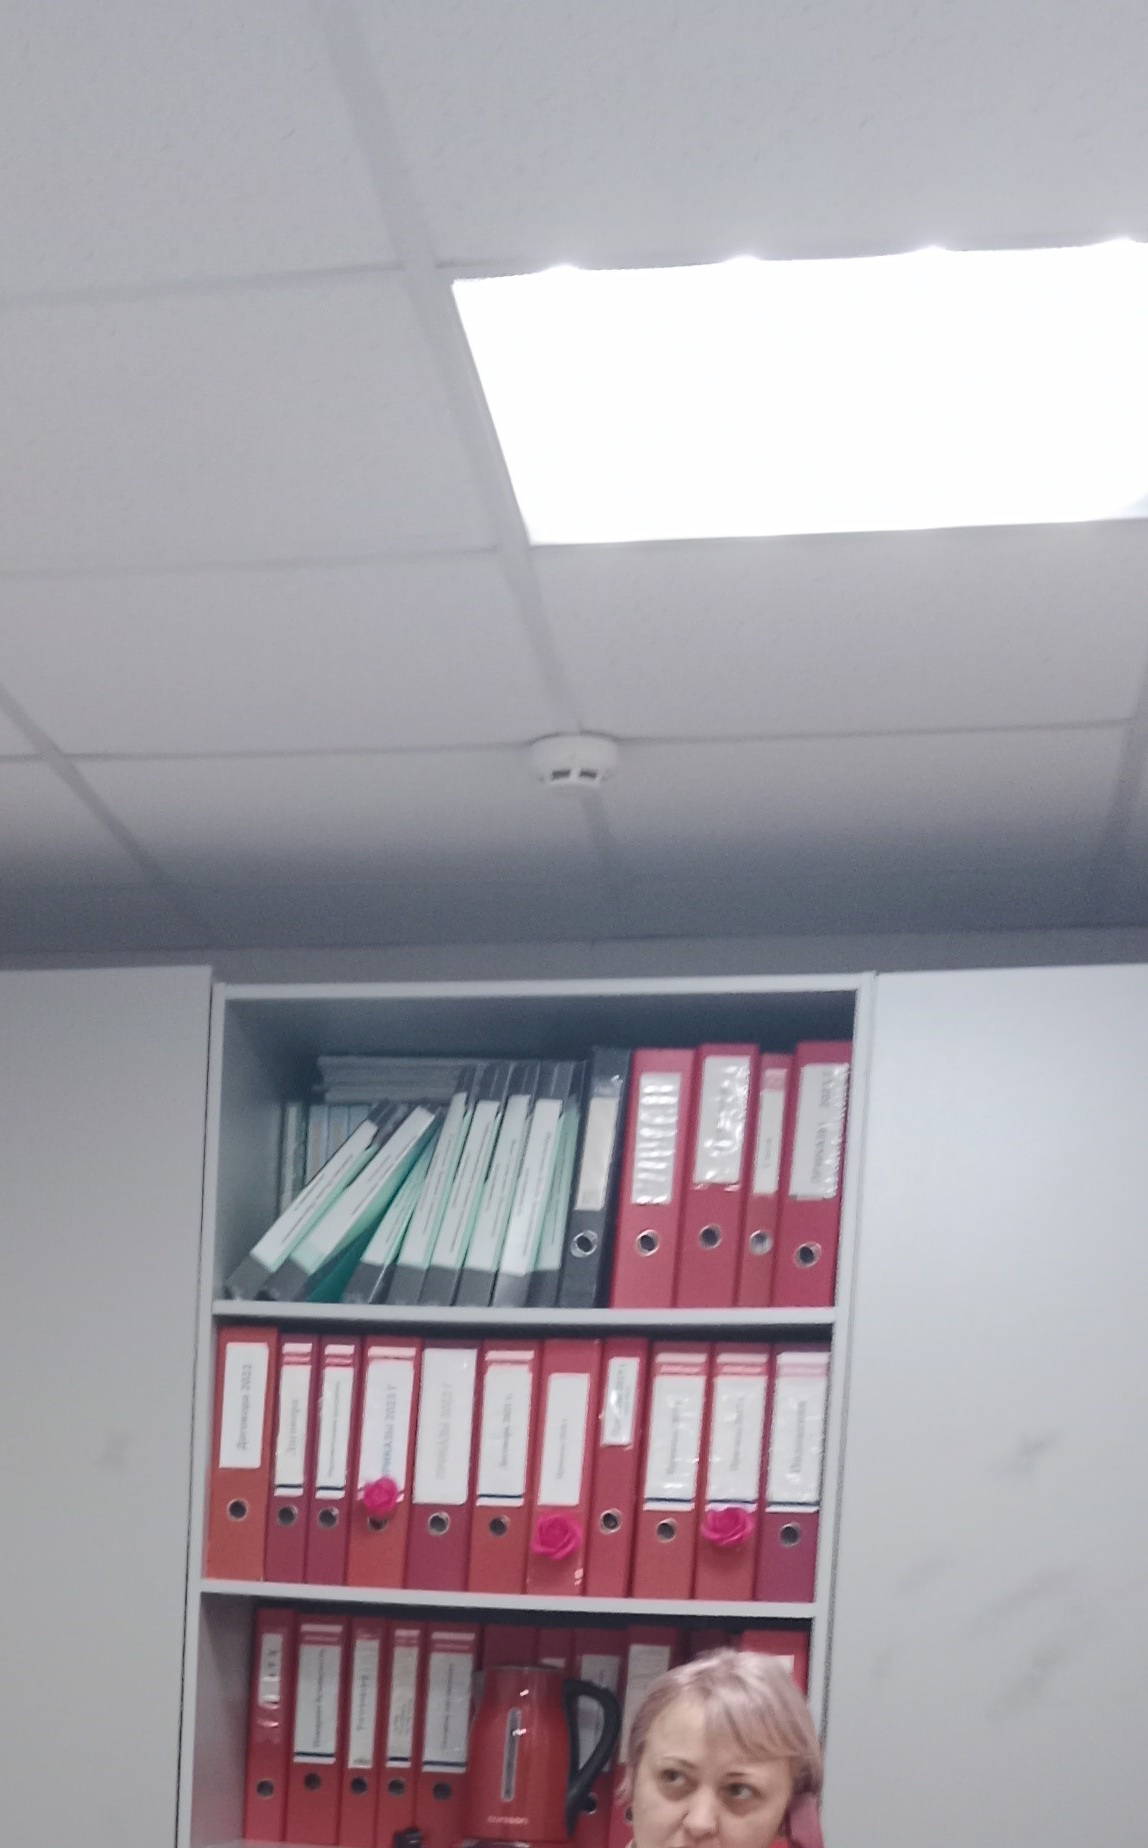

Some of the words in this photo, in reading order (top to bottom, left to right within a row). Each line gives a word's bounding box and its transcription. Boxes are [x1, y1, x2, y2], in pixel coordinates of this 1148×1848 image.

[235, 1394, 251, 1451] Договора
[285, 1398, 300, 1457] Договора
[385, 1393, 397, 1421] 2023
